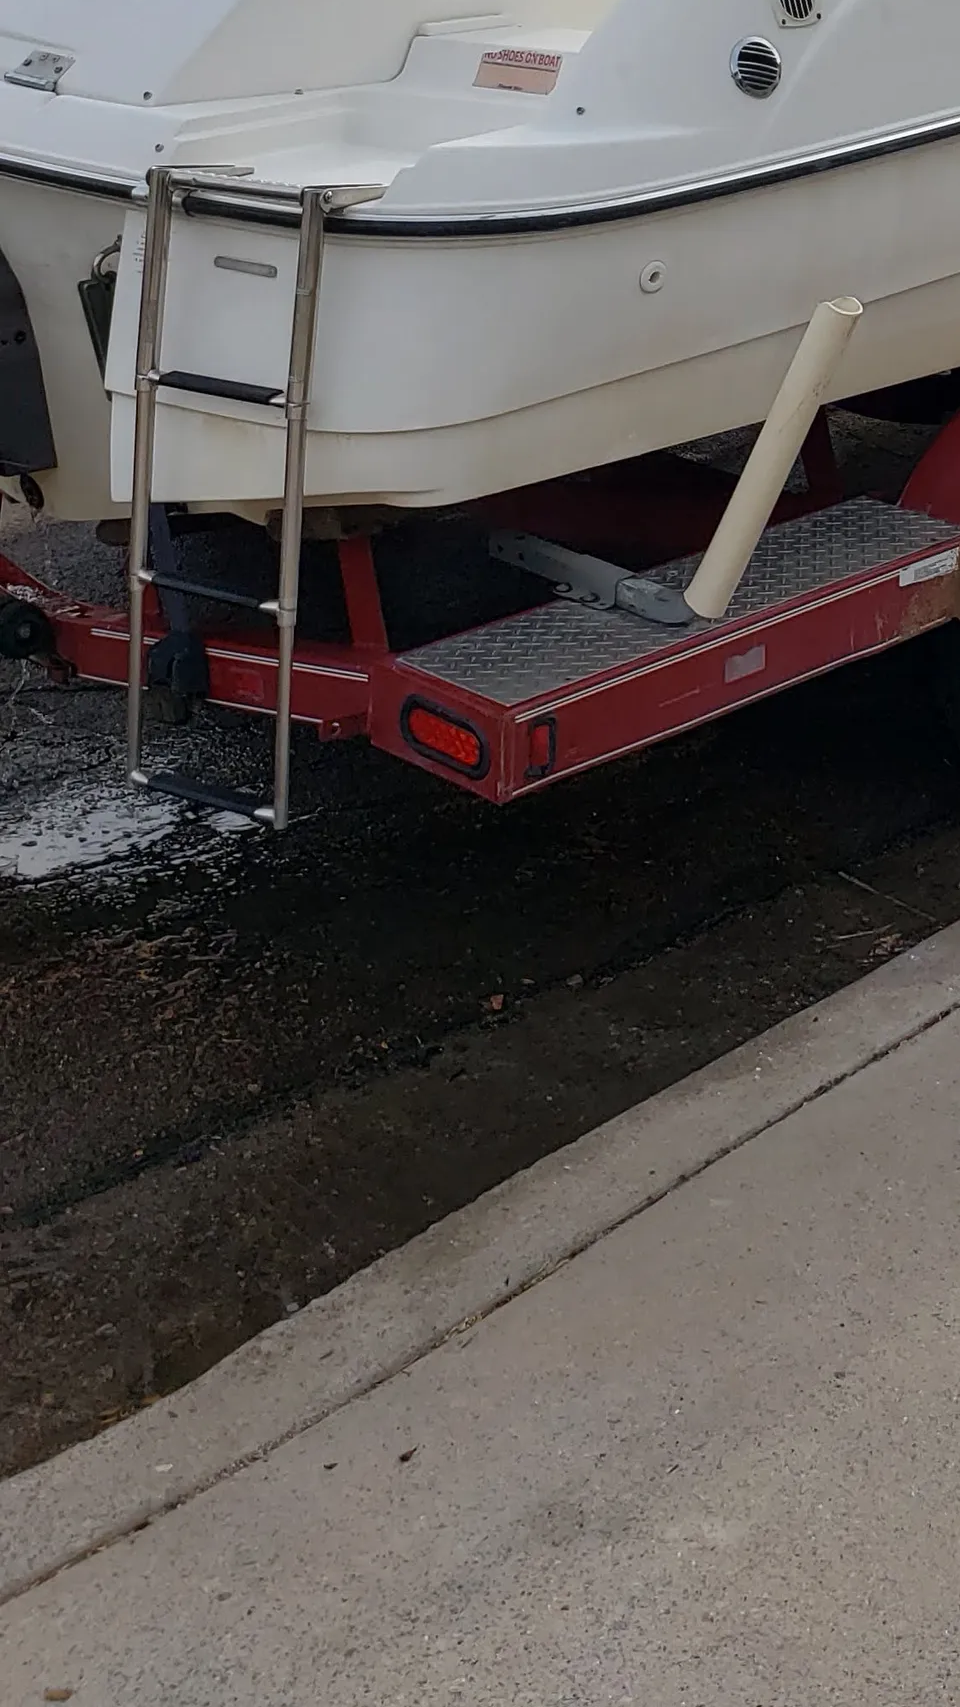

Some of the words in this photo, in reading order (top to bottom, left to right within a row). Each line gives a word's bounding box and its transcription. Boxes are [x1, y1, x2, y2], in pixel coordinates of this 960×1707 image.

[498, 50, 524, 63] SHOES
[525, 52, 539, 65] ON
[540, 54, 561, 68] BOAT
